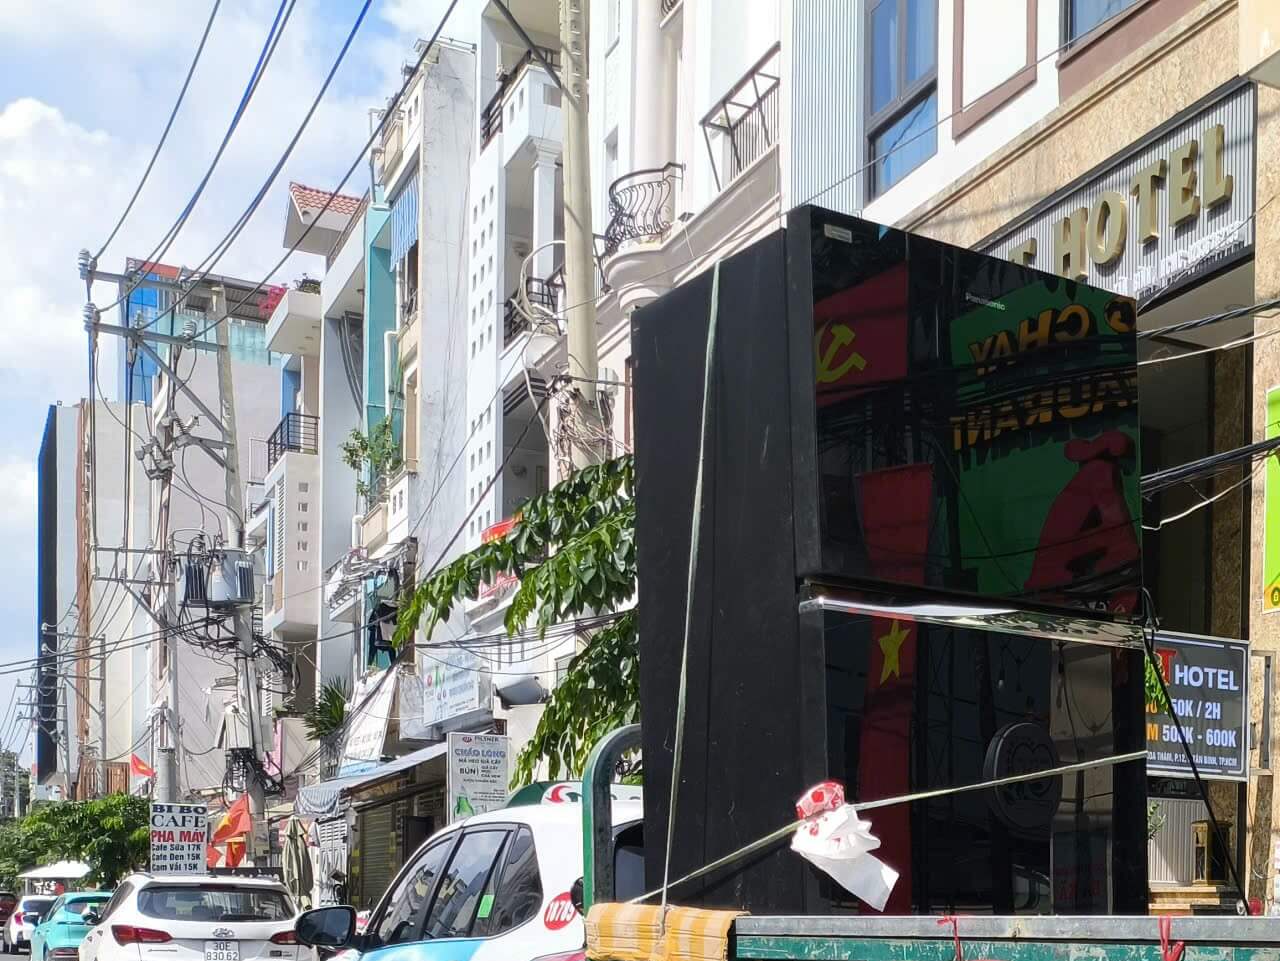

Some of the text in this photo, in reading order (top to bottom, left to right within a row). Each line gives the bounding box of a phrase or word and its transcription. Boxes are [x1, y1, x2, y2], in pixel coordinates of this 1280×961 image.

[1053, 124, 1234, 281] HOTEL
[965, 292, 1006, 311] Panasonic
[1174, 664, 1239, 691] HOTEL
[1204, 702, 1221, 720] 2H
[1205, 728, 1237, 748] 600K
[152, 804, 207, 815] BI BO
[152, 814, 206, 828] CAFE
[151, 830, 175, 843] PHA
[188, 843, 201, 852] 17K
[187, 853, 201, 861] 15K
[184, 863, 198, 871] 15K
